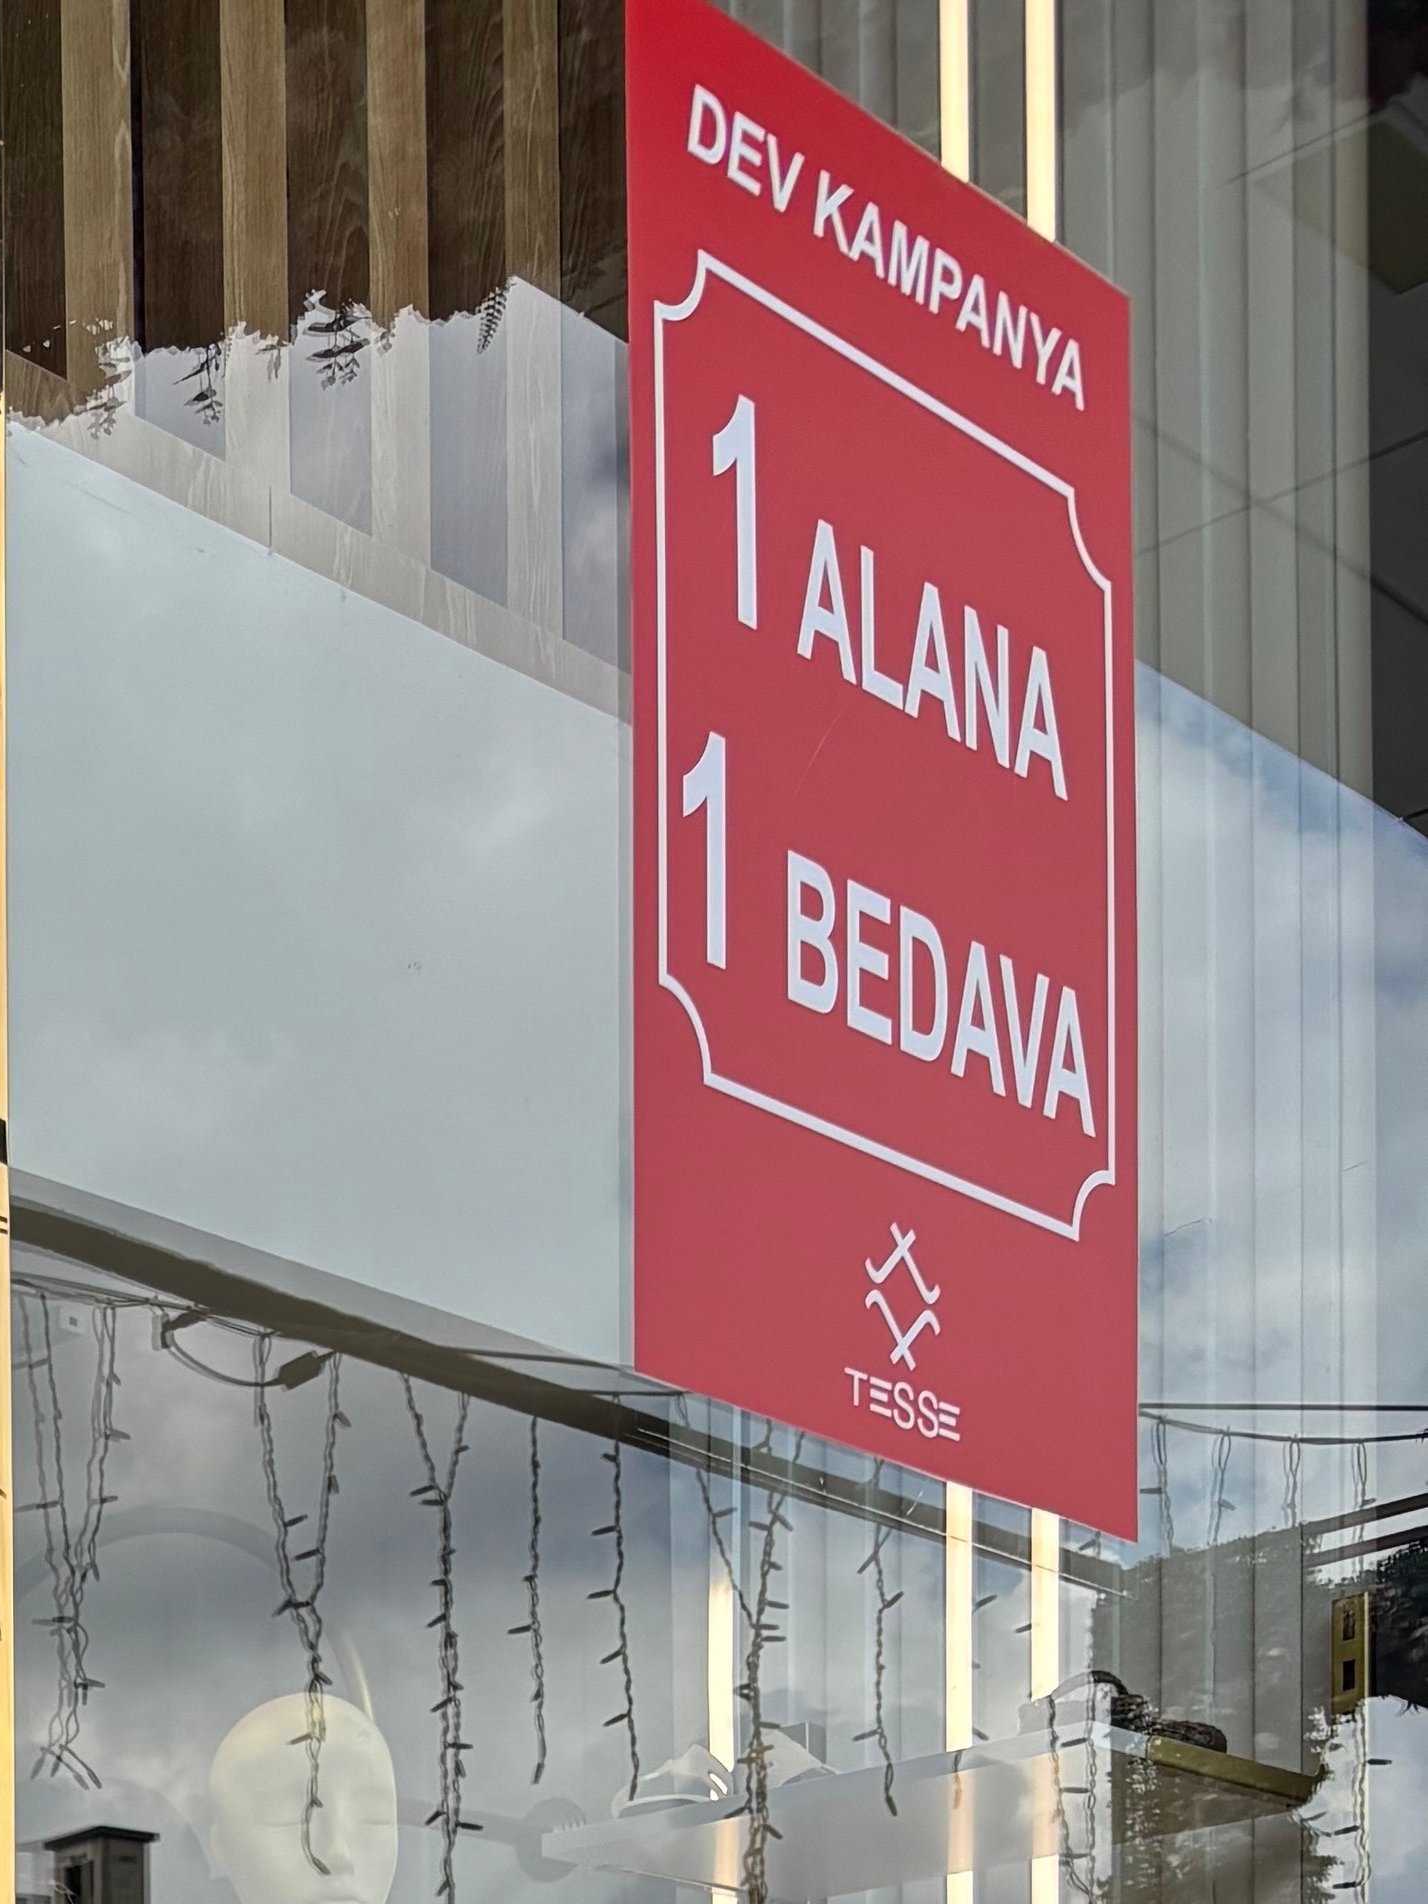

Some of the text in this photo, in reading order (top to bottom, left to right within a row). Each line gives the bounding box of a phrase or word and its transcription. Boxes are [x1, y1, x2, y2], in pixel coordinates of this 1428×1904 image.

[687, 84, 1085, 412] DEV KAMPANYA
[711, 393, 1069, 802] 1 ALANA
[681, 730, 1097, 1139] 1 BEDAVA
[844, 1367, 961, 1443] TESSE
